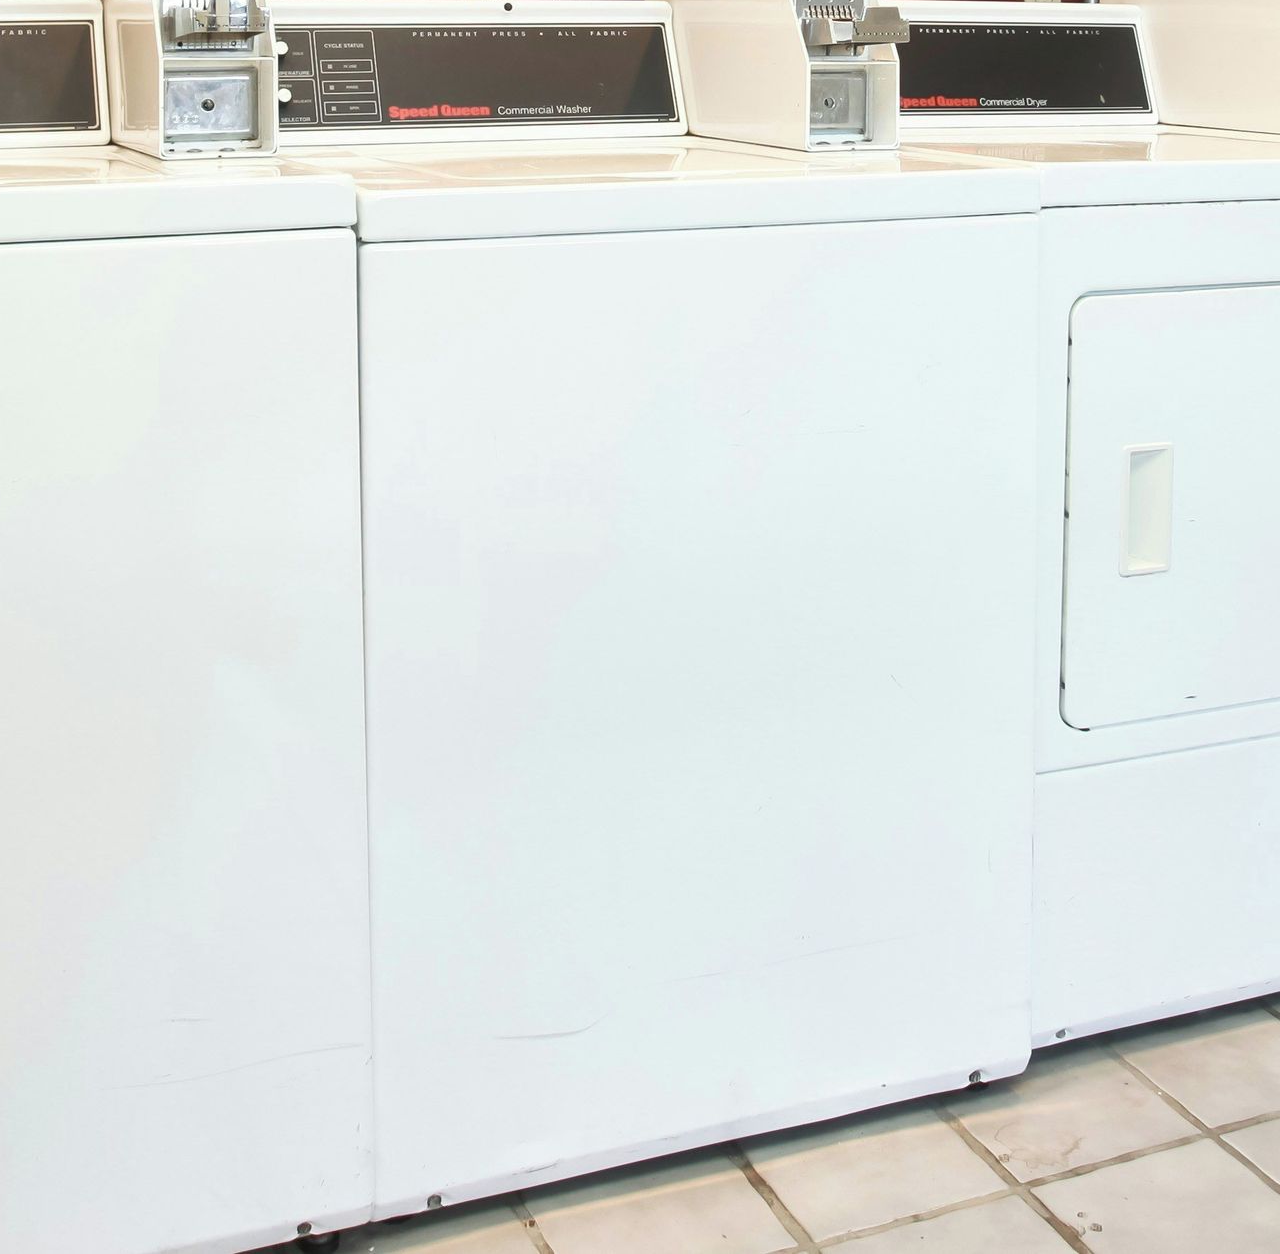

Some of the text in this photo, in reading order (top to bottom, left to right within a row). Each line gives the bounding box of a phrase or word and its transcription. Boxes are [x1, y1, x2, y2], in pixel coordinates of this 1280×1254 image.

[900, 96, 1048, 108] peed Queen Commercial Dryer
[388, 104, 592, 120] Speed Queen Commercial Washer
